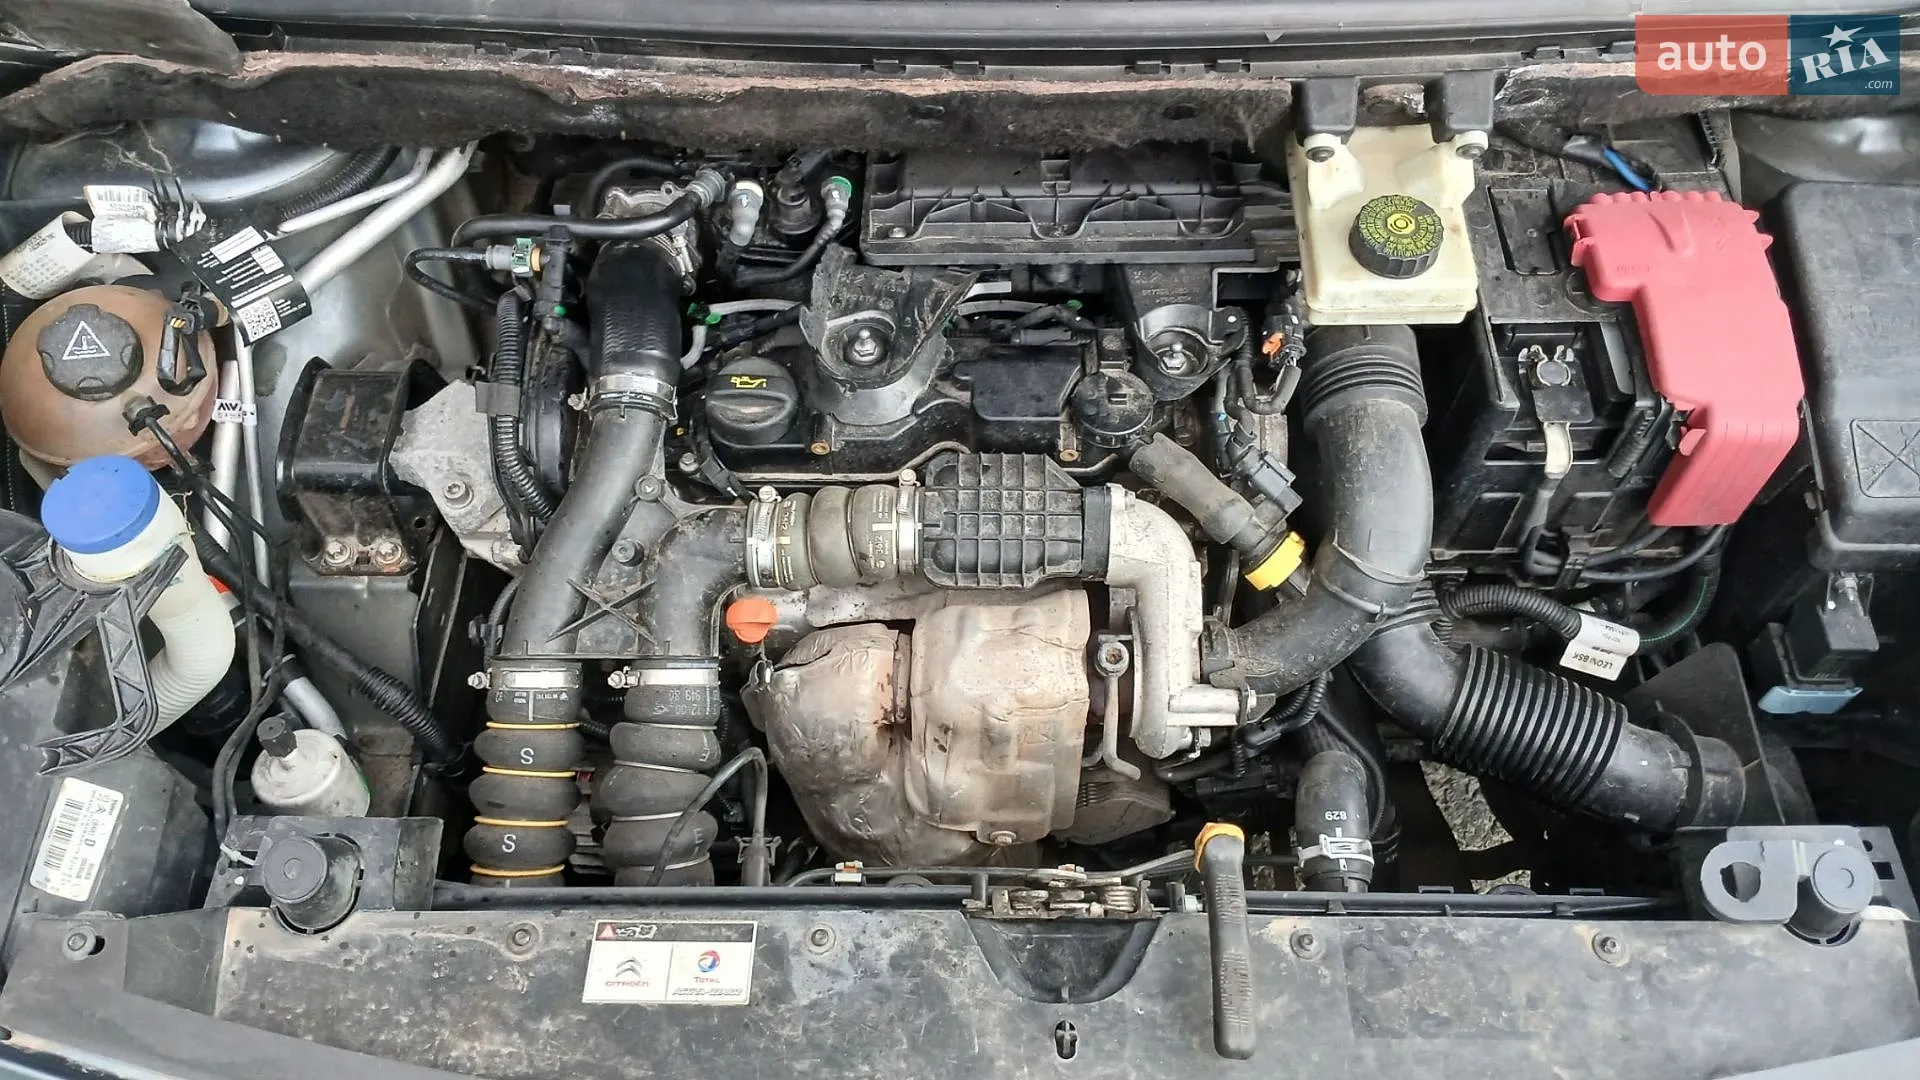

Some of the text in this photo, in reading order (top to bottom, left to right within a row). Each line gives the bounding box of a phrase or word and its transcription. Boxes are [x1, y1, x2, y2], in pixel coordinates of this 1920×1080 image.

[1572, 652, 1590, 664] BSK
[519, 747, 535, 765] S
[502, 834, 517, 853] S
